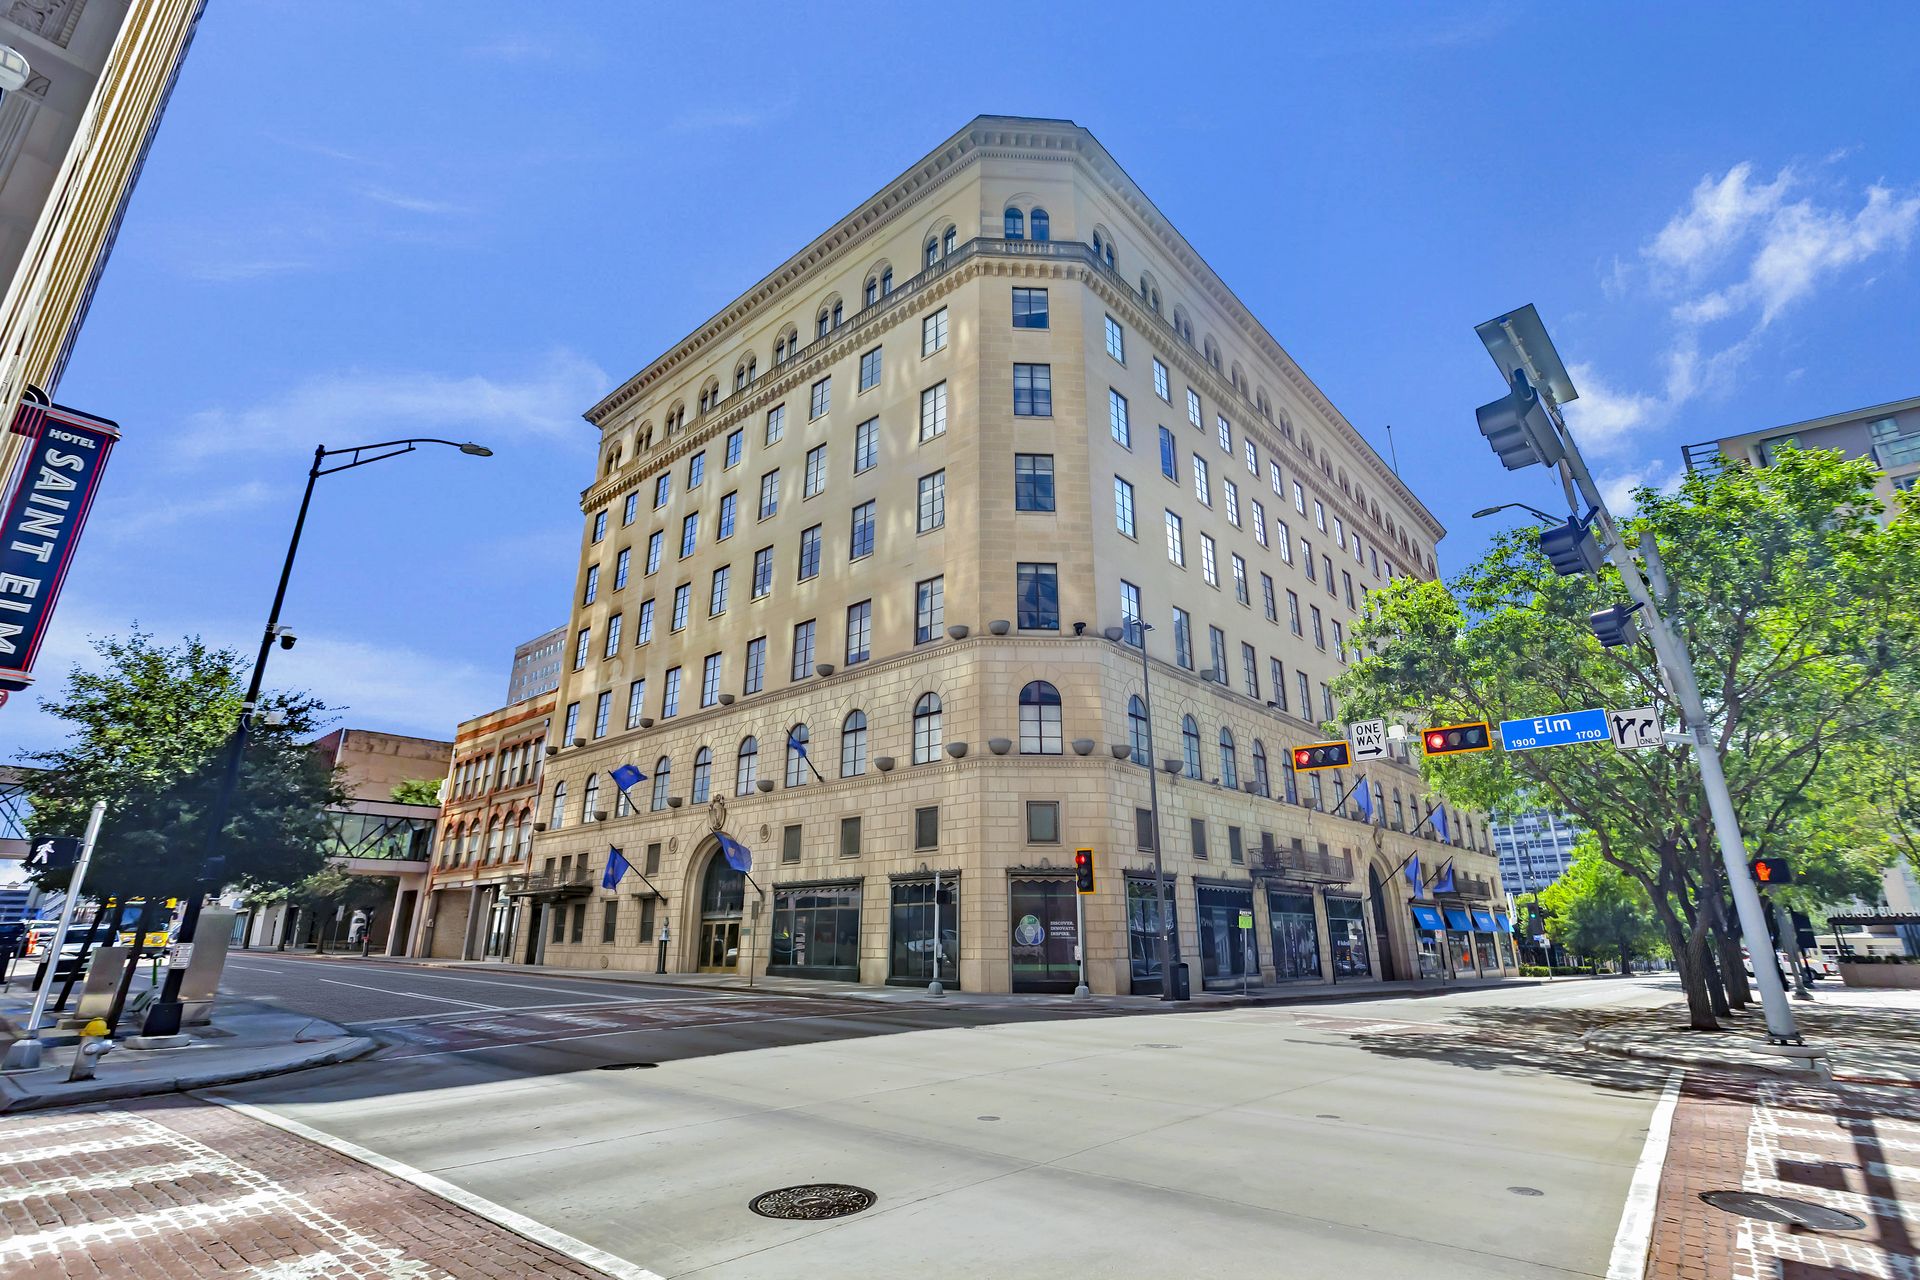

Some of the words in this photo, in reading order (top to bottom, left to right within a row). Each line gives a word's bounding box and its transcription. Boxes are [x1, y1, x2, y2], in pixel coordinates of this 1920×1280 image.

[49, 428, 95, 449] HOTEL
[10, 447, 85, 564] SAINT
[1356, 723, 1380, 735] ONE
[1533, 717, 1571, 735] Elm
[1356, 734, 1381, 746] WAY
[1511, 737, 1536, 747] 1900
[1575, 729, 1602, 740] 1700
[1639, 736, 1660, 744] ONLY
